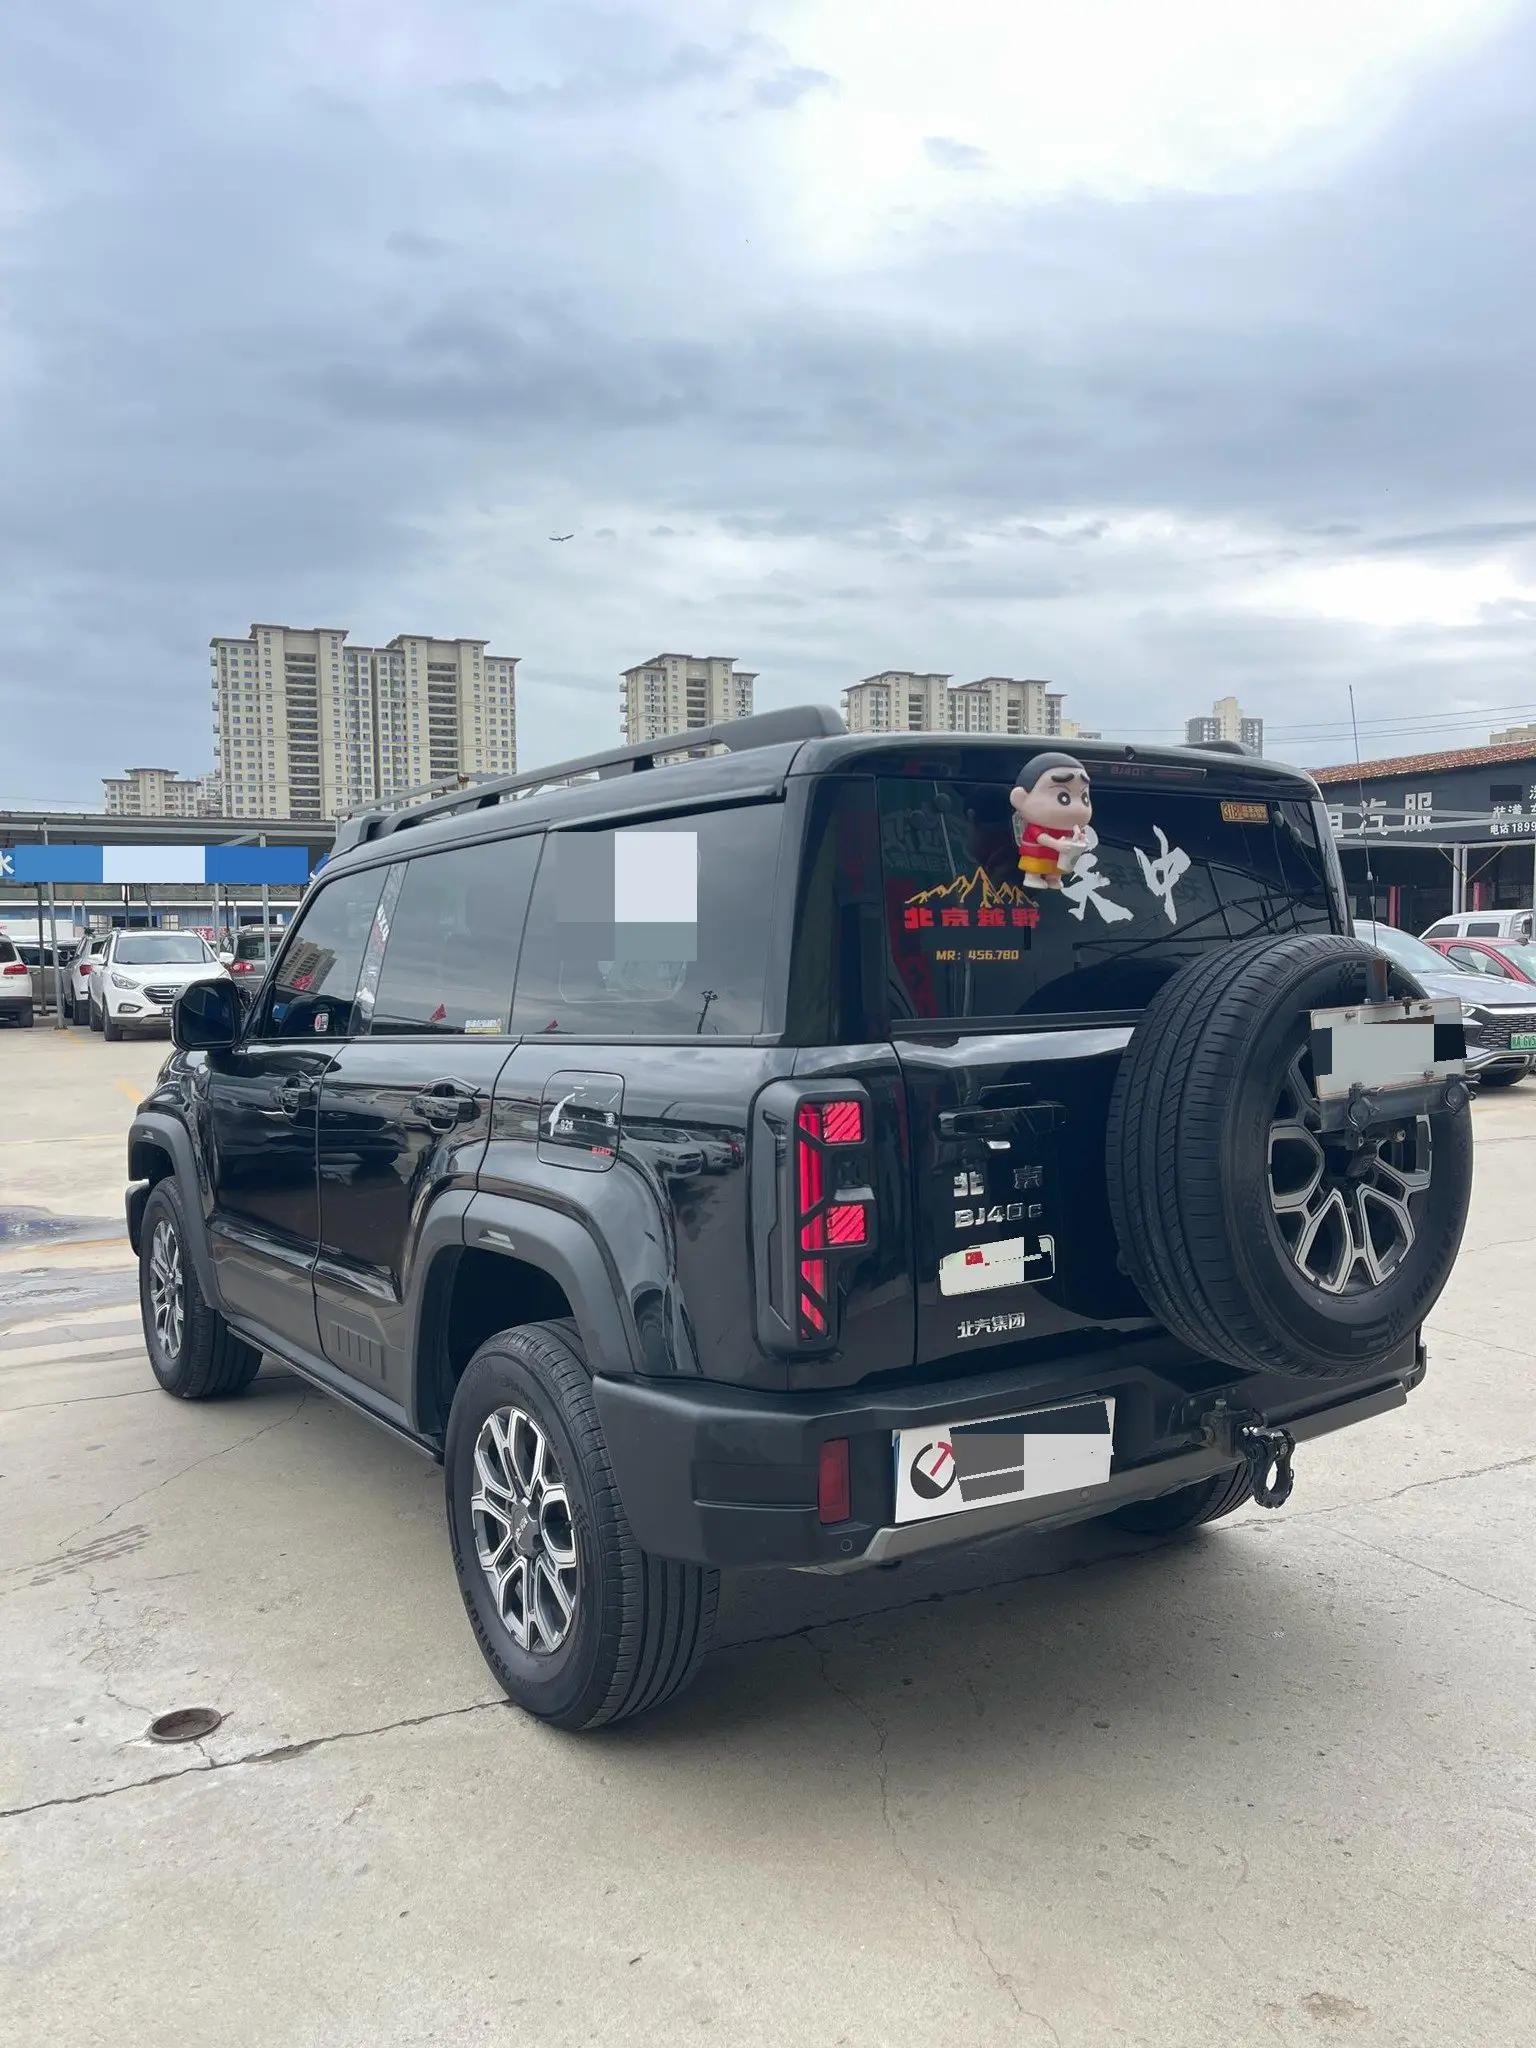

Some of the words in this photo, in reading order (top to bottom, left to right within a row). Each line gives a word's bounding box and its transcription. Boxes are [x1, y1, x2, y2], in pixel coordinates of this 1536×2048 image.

[904, 907, 1040, 929] 北京越野
[953, 1165, 1043, 1197] 北京
[957, 1312, 1026, 1339] 北汽集团
